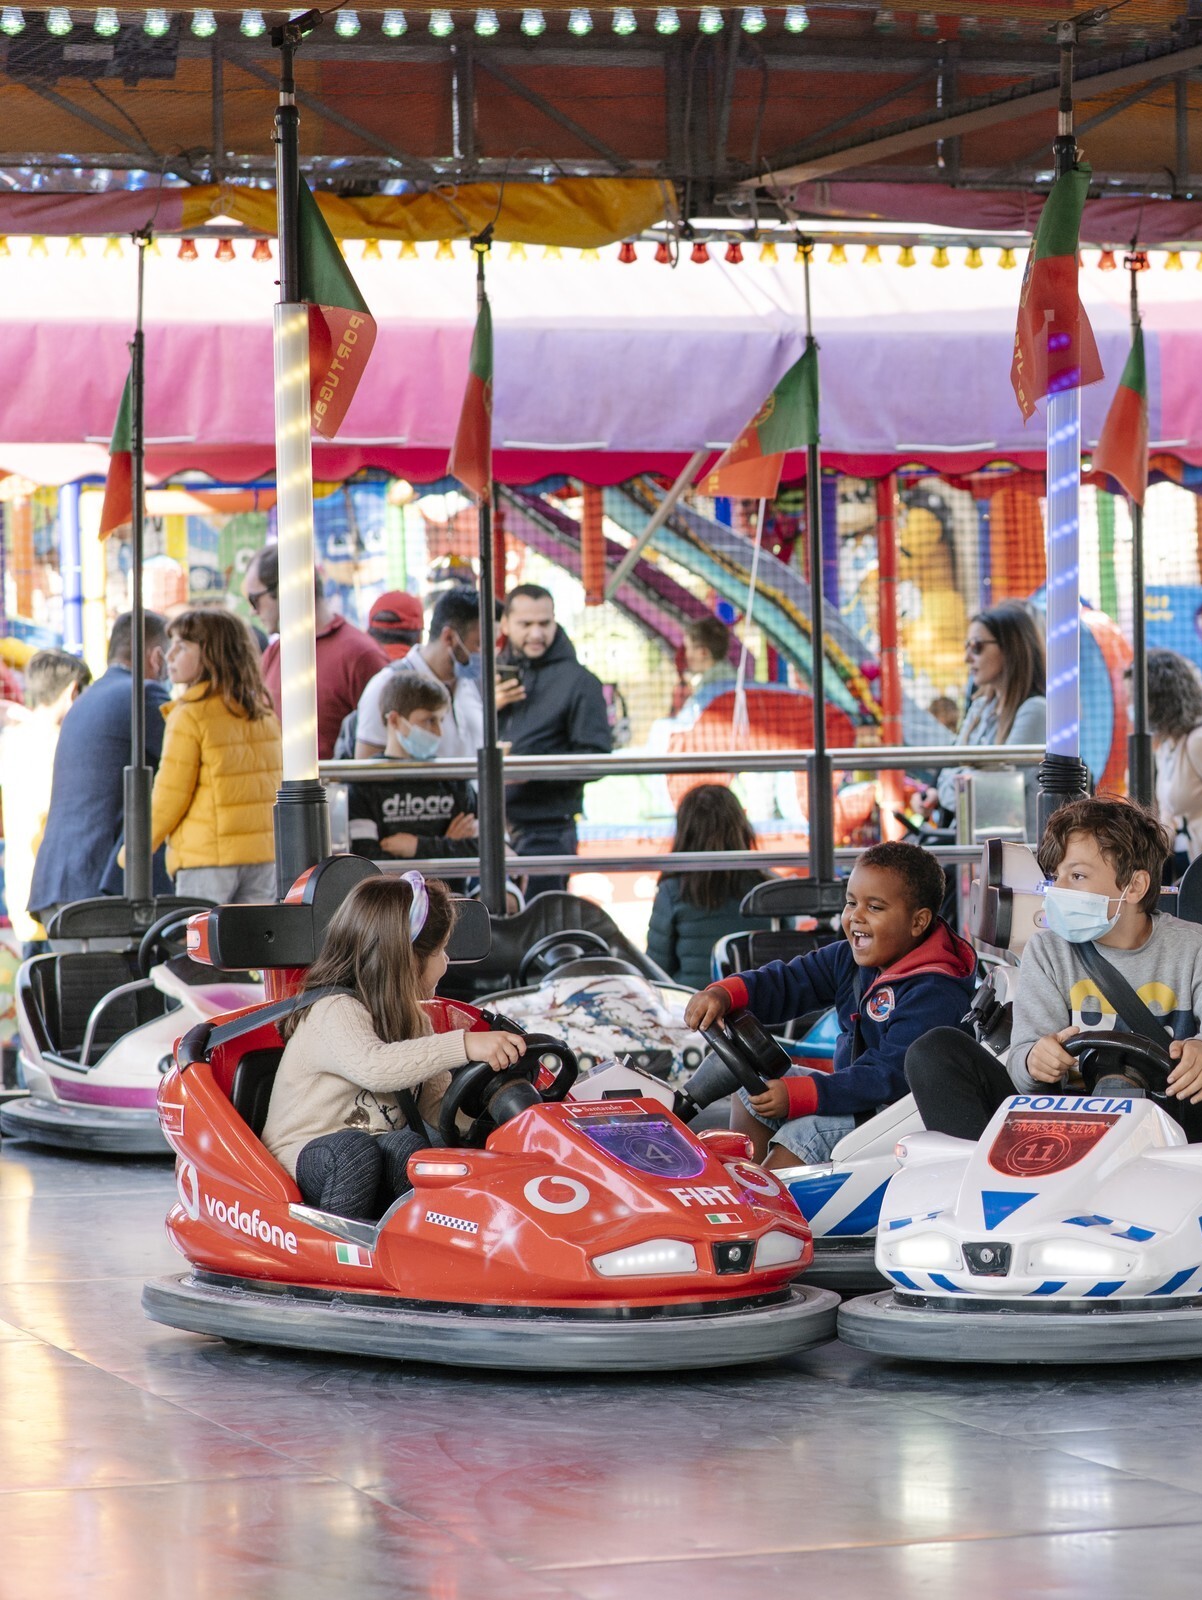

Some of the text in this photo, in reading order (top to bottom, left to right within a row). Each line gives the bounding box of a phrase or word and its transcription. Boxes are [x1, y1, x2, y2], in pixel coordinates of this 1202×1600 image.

[582, 1104, 623, 1112] Santander
[1008, 1096, 1133, 1113] POLICIA
[1069, 1125, 1098, 1134] SILVA
[646, 1143, 674, 1164] 4
[1017, 1143, 1055, 1161] 11
[668, 1185, 740, 1207] FIAT
[204, 1193, 298, 1255] vodafone
